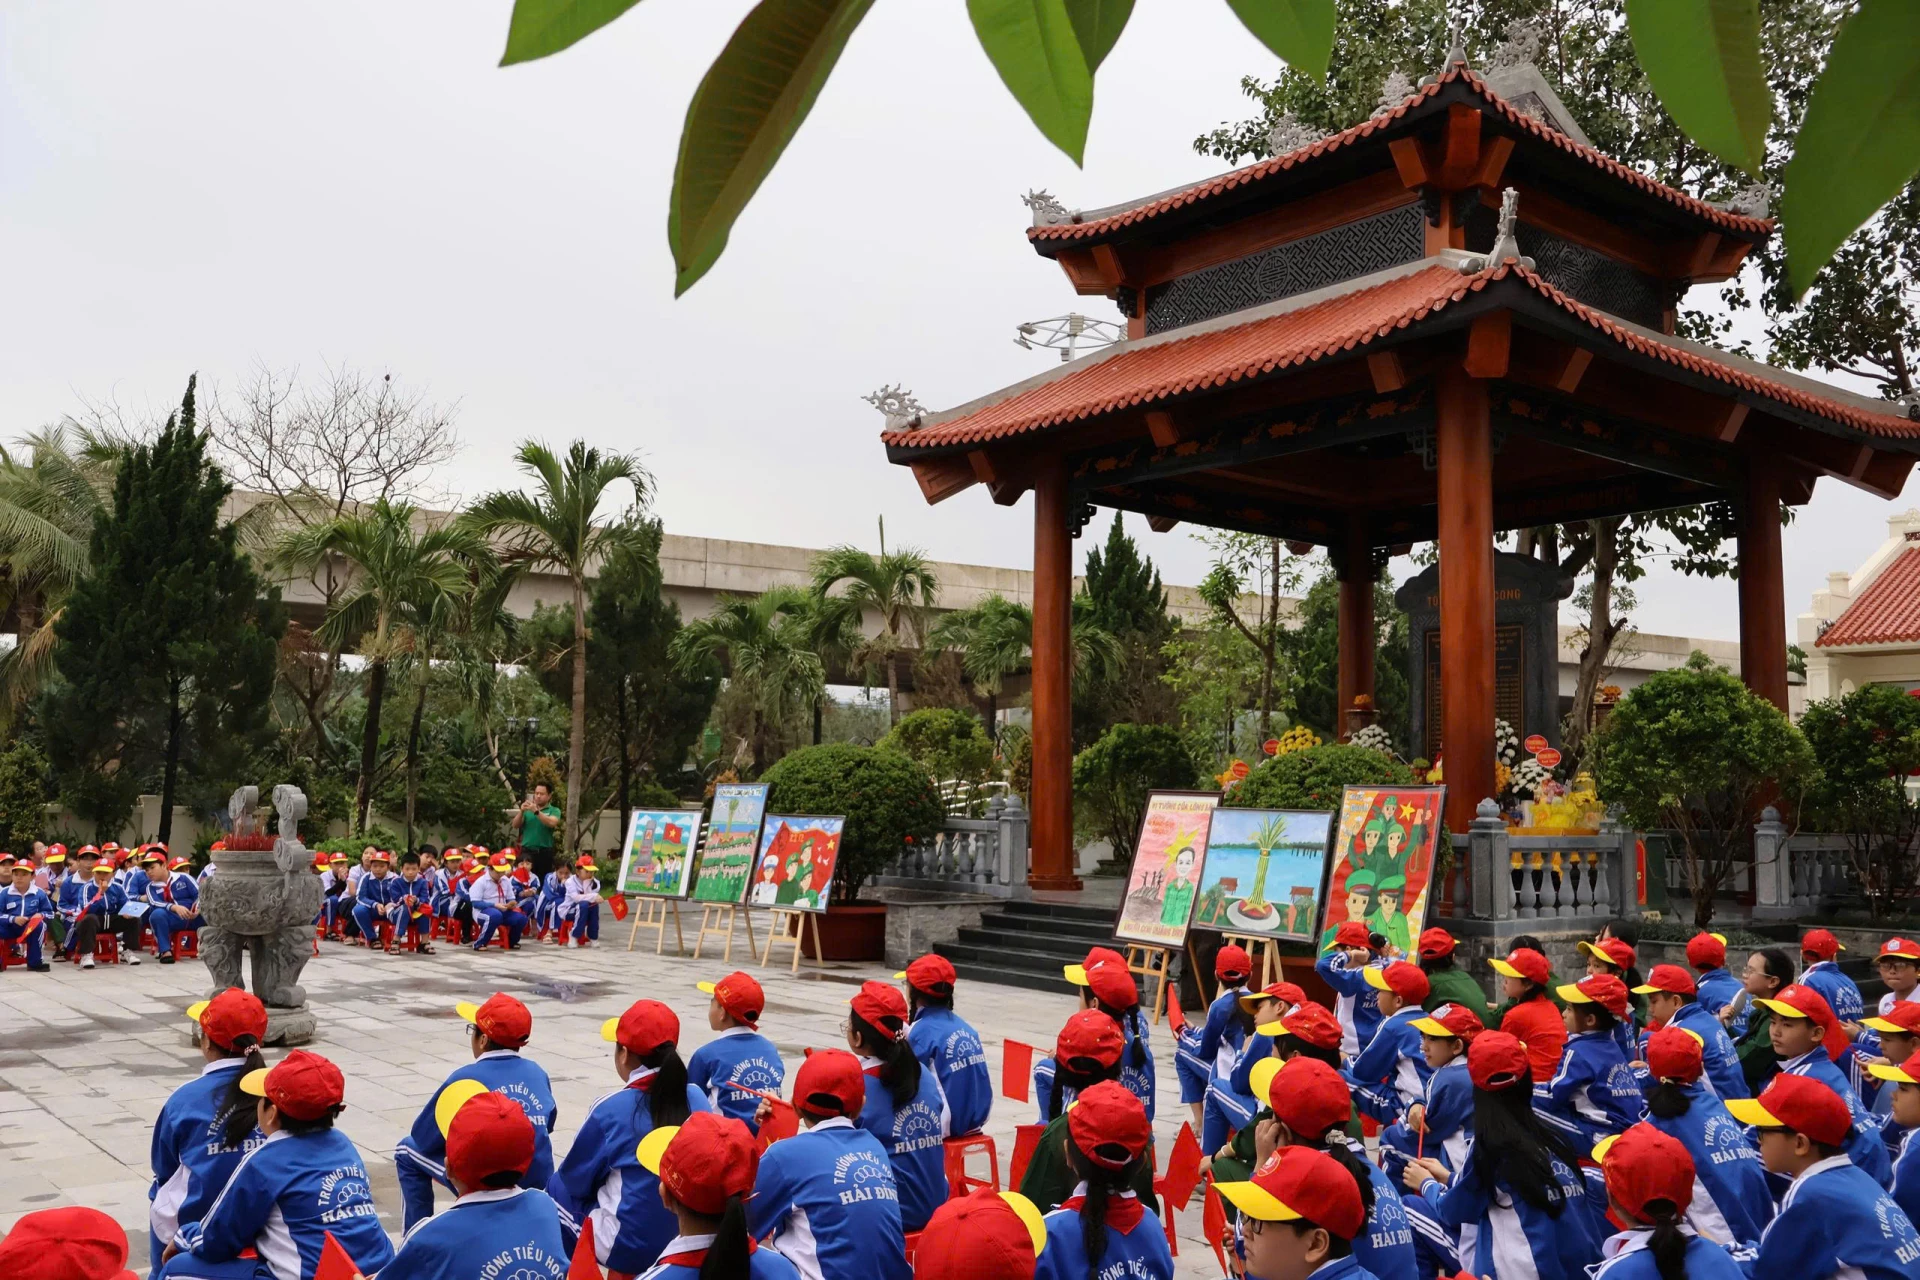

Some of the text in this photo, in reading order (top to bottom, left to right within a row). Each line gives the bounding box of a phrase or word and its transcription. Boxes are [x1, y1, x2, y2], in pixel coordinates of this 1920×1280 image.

[730, 1056, 783, 1083] RƯỜNG TIỂU HỌC
[949, 1057, 968, 1073] HẢI
[1138, 1073, 1151, 1091] HỌC
[508, 1081, 529, 1096] TIỂU
[529, 1092, 544, 1111] HỌC
[892, 1099, 942, 1138] TRƯỜNG TIỂU HỌC
[894, 1133, 944, 1154] HẢI ĐÌNH
[1710, 1146, 1738, 1164] HẢI
[833, 1152, 860, 1185] TRƯỜNG
[856, 1150, 880, 1165] TIỂU
[317, 1168, 345, 1207] TRƯỜNG
[342, 1162, 365, 1179] TIỂU
[838, 1183, 874, 1206] HẢI
[320, 1203, 355, 1224] HẢI
[1371, 1226, 1398, 1249] HẢI
[513, 1240, 544, 1263] TIỂU
[1127, 1255, 1149, 1280] TIỂU
